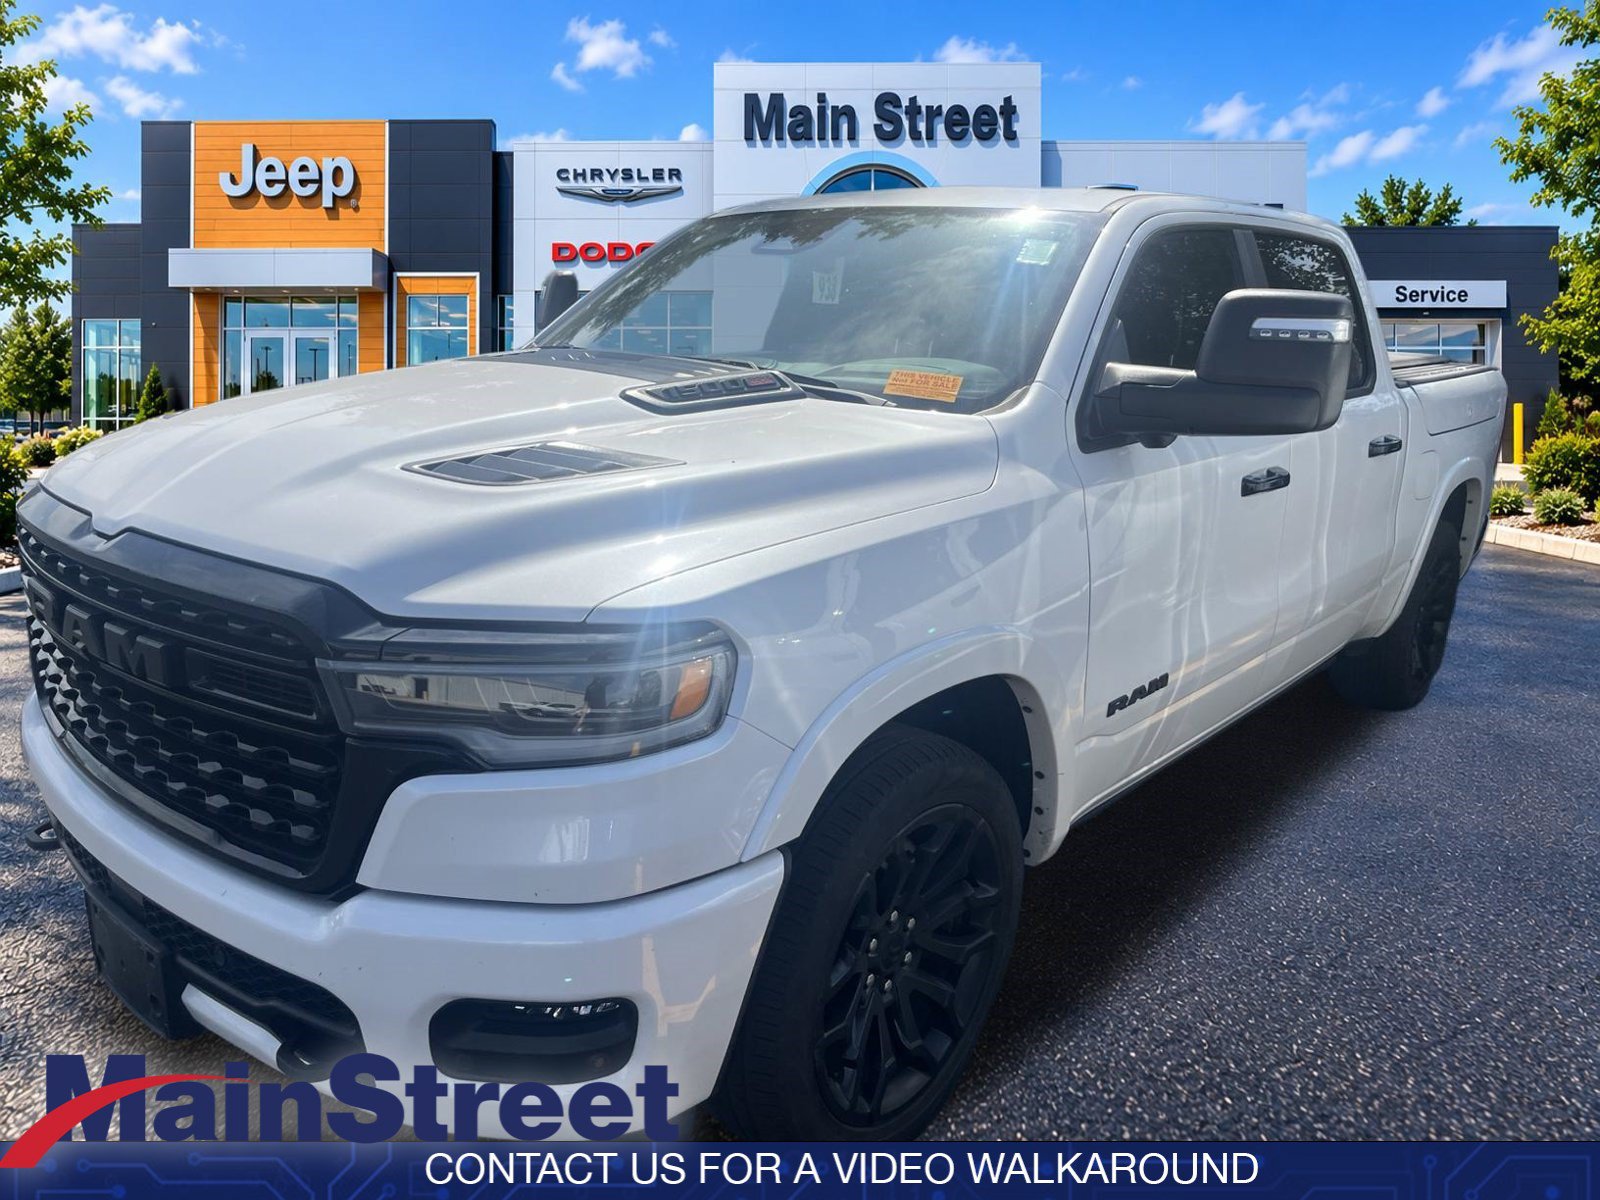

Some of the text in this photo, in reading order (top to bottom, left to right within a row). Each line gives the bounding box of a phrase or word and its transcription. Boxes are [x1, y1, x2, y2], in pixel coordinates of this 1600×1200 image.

[744, 91, 1017, 141] Main Street
[219, 143, 354, 208] Jeep
[556, 168, 683, 181] CHRYSLER
[1395, 285, 1469, 303] Service
[918, 373, 960, 383] VEHICLE
[931, 381, 959, 390] SALE
[24, 574, 167, 688] RAM
[1106, 672, 1169, 718] RAM
